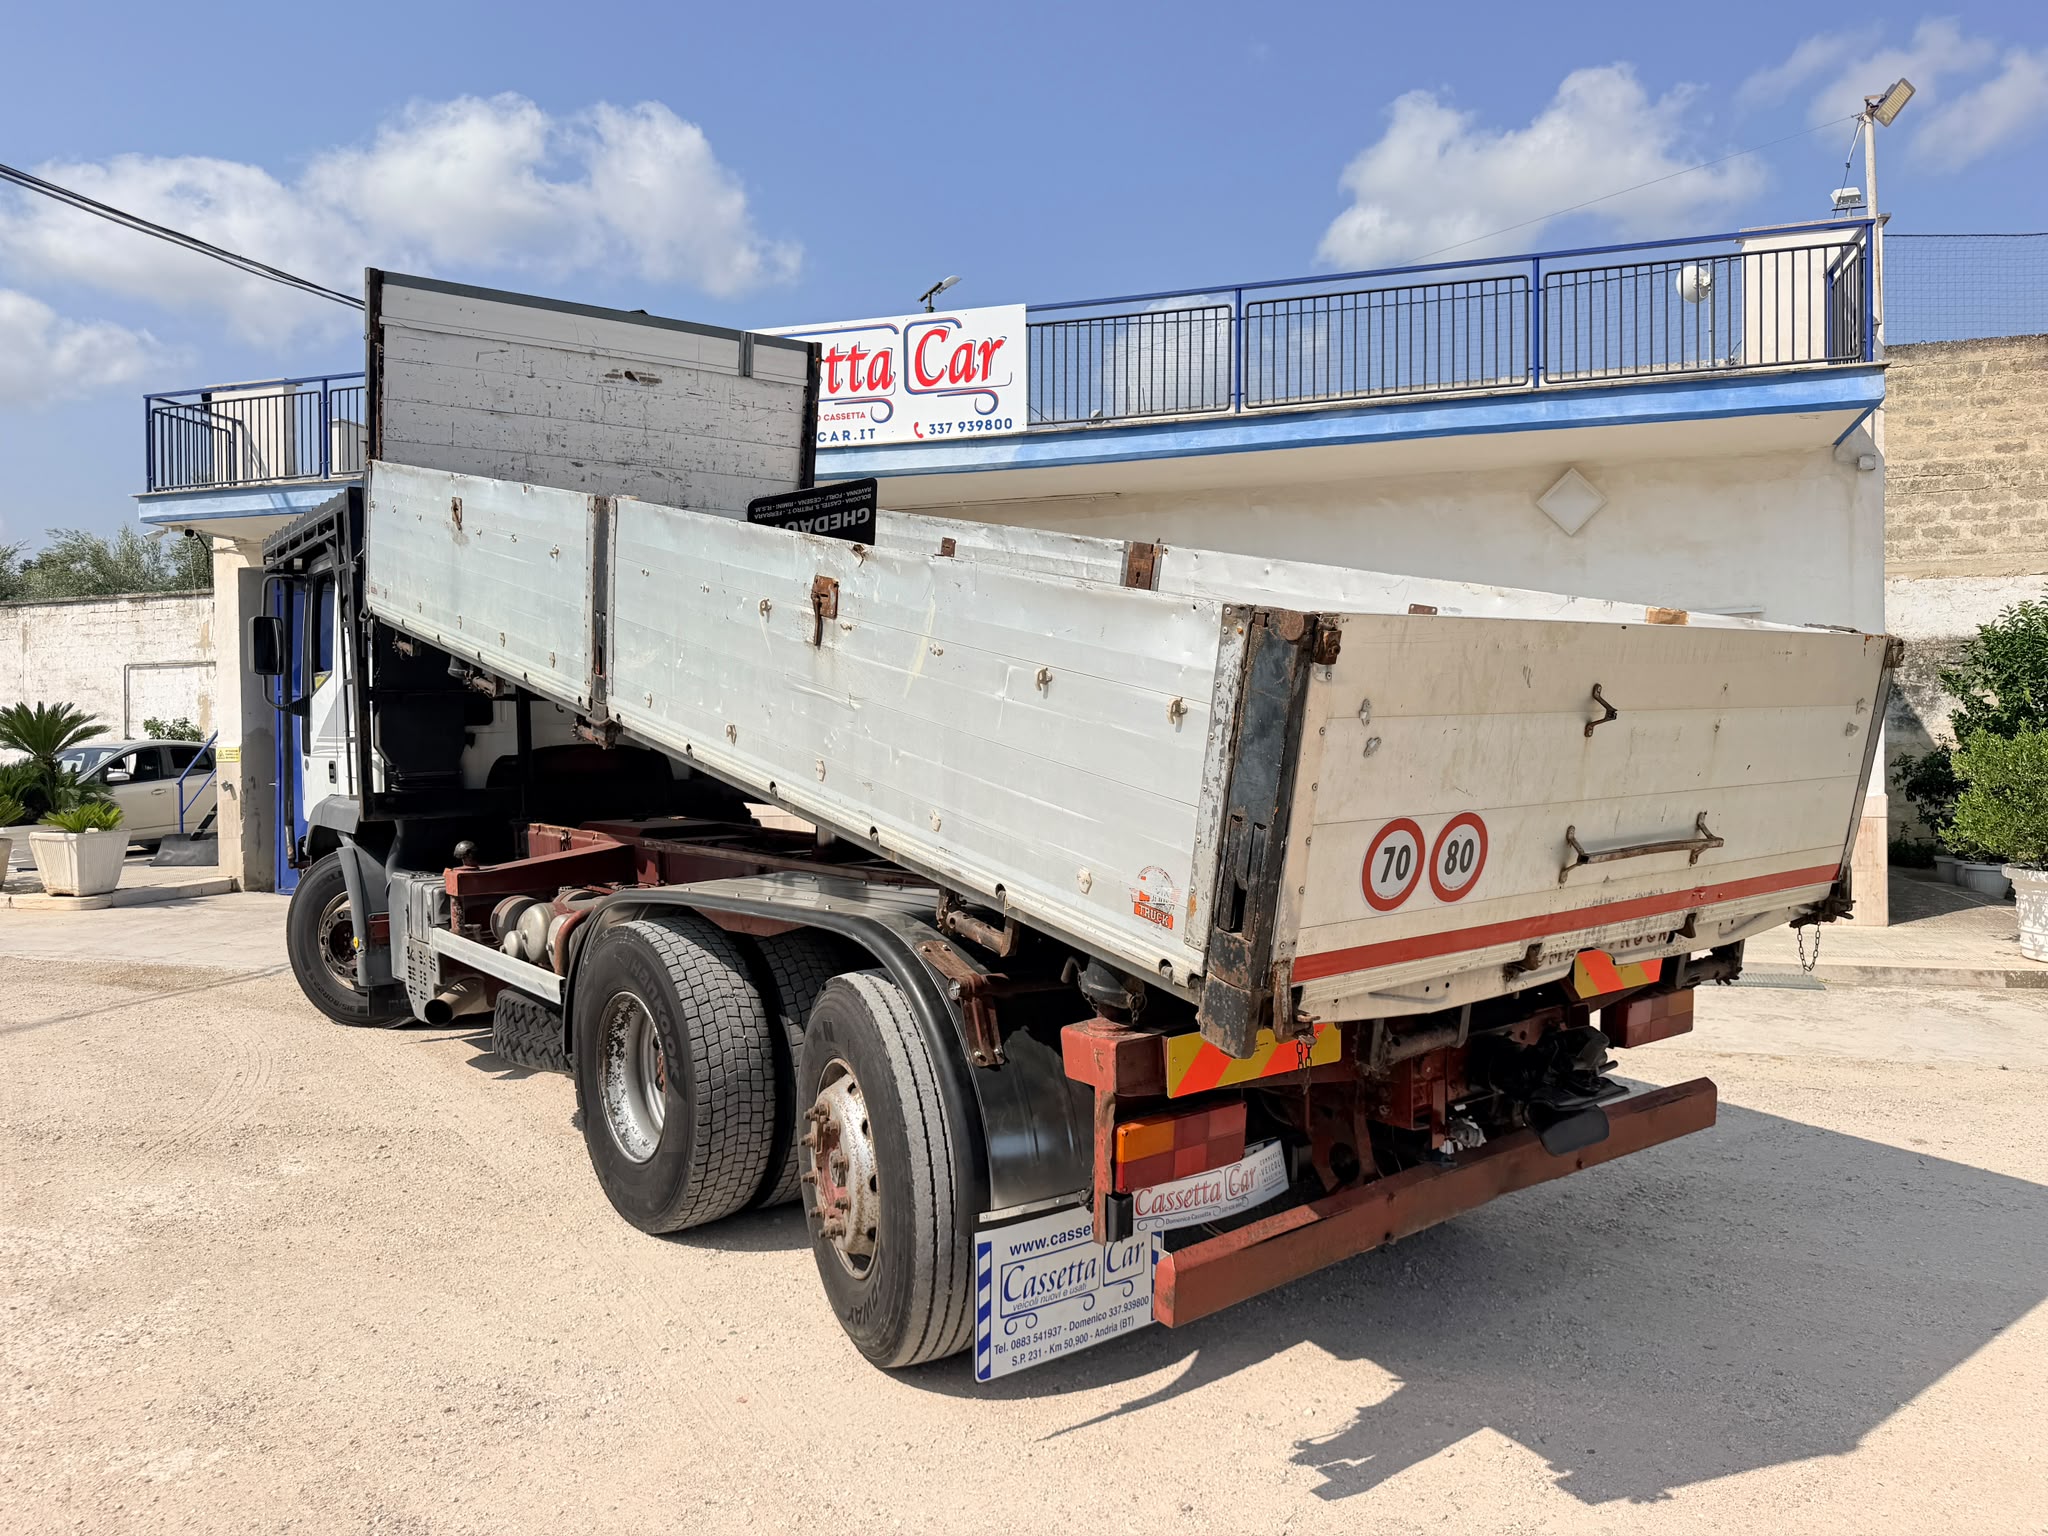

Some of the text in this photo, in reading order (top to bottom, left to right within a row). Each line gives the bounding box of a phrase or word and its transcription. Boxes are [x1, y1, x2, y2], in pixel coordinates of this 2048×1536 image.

[820, 325, 1007, 394] tta Car
[823, 411, 866, 421] CASSETTA
[817, 417, 1013, 442] CAR.IT 337 939800
[798, 496, 822, 505] CESENA
[845, 493, 872, 503] BOLOGNA
[846, 486, 872, 497] RAVENNA
[754, 510, 783, 520] FERRARA
[775, 501, 794, 509] RIMINI
[792, 505, 814, 513] PIETRO
[820, 499, 842, 508] CASTEL
[1380, 838, 1475, 883] 70 80
[1139, 904, 1169, 927] TRUCK
[1135, 1165, 1257, 1216] Cassetta Car
[1003, 1241, 1145, 1302] Cassetta Car
[1012, 1295, 1039, 1311] veicoli
[1040, 1289, 1062, 1303] nuovi
[1069, 1282, 1087, 1295] usati
[994, 1342, 1008, 1355] Tel.
[1010, 1336, 1031, 1350] 0883
[1033, 1325, 1062, 1344] 541937
[1069, 1311, 1107, 1331] Domenico
[1109, 1295, 1149, 1318] 337.939800
[1011, 1353, 1026, 1367] S.P.
[1028, 1347, 1042, 1361] 231
[1049, 1342, 1062, 1354] Km
[1064, 1333, 1089, 1350] 50,900
[1094, 1324, 1118, 1339] Andria
[1119, 1315, 1135, 1331] (BT)
